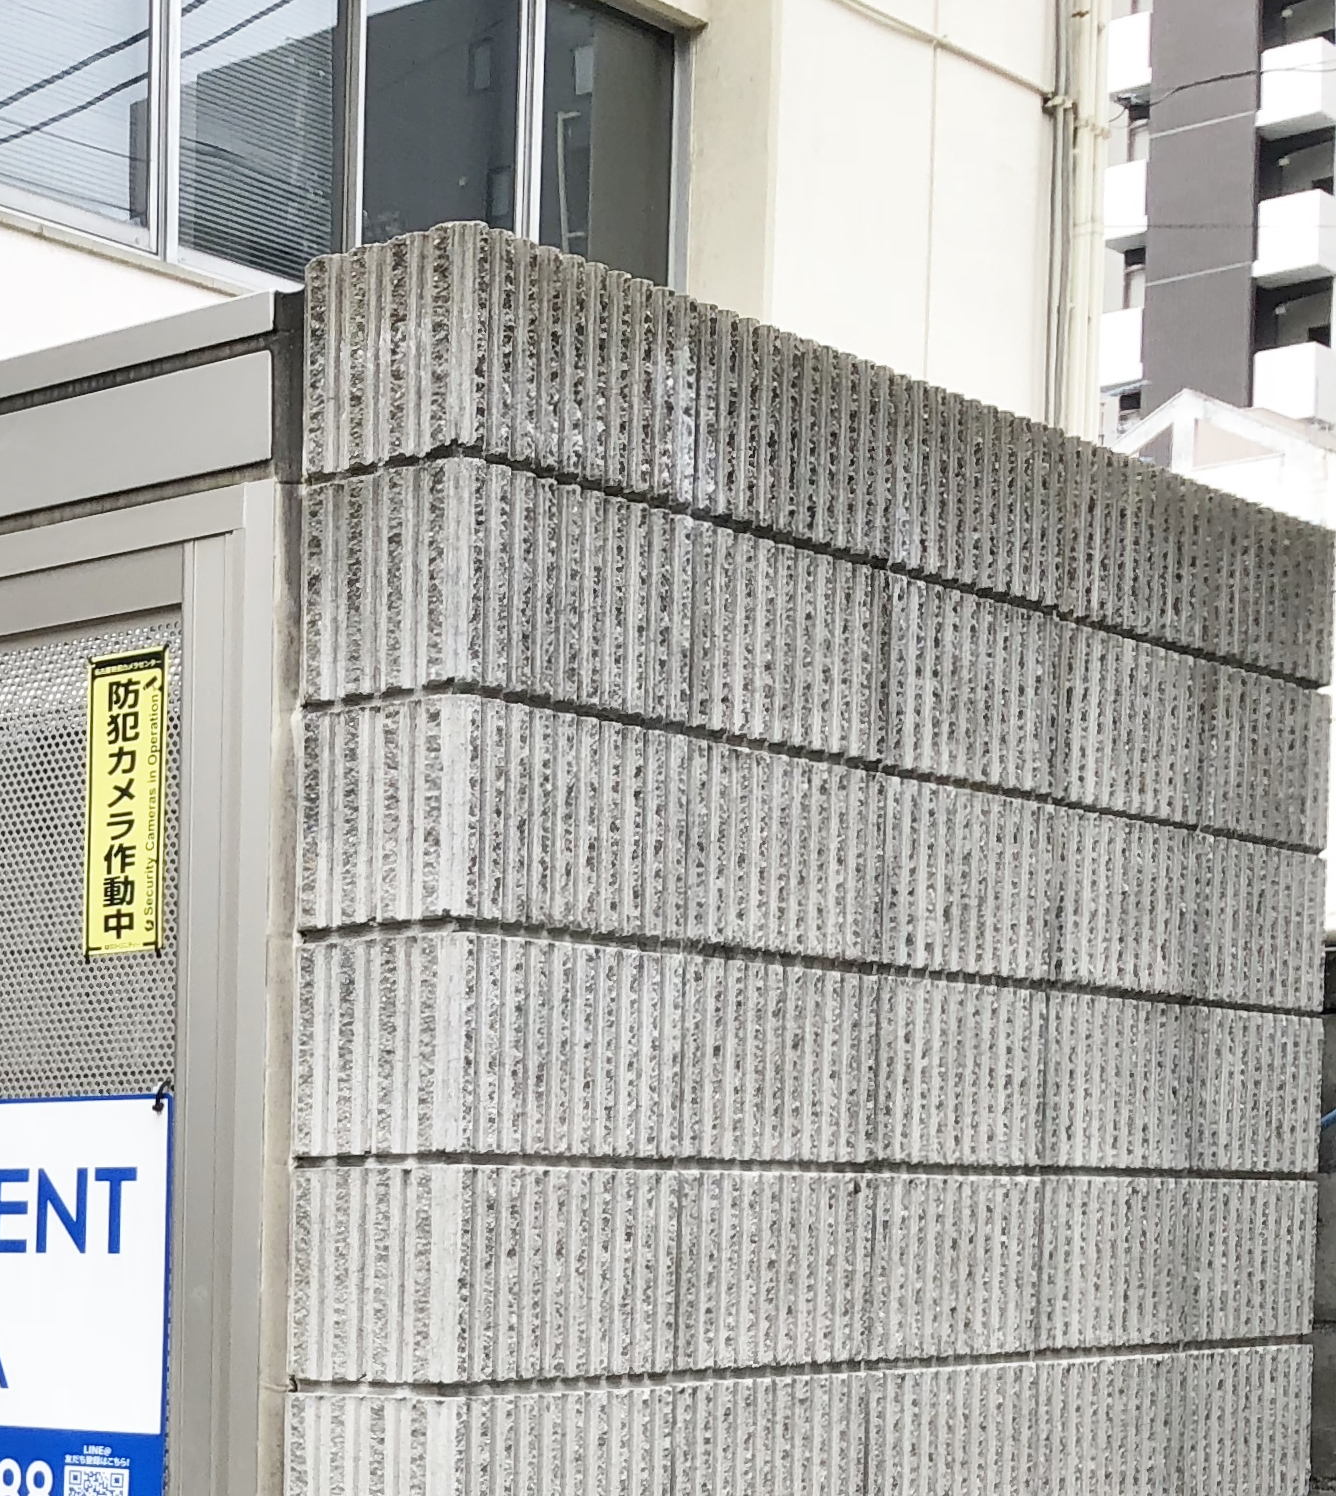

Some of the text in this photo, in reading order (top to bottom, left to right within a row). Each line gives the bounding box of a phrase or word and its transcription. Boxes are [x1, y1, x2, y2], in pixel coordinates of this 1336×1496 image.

[102, 677, 141, 940] 防犯カメラ作動中
[144, 693, 161, 916] Security Cameras in Operation
